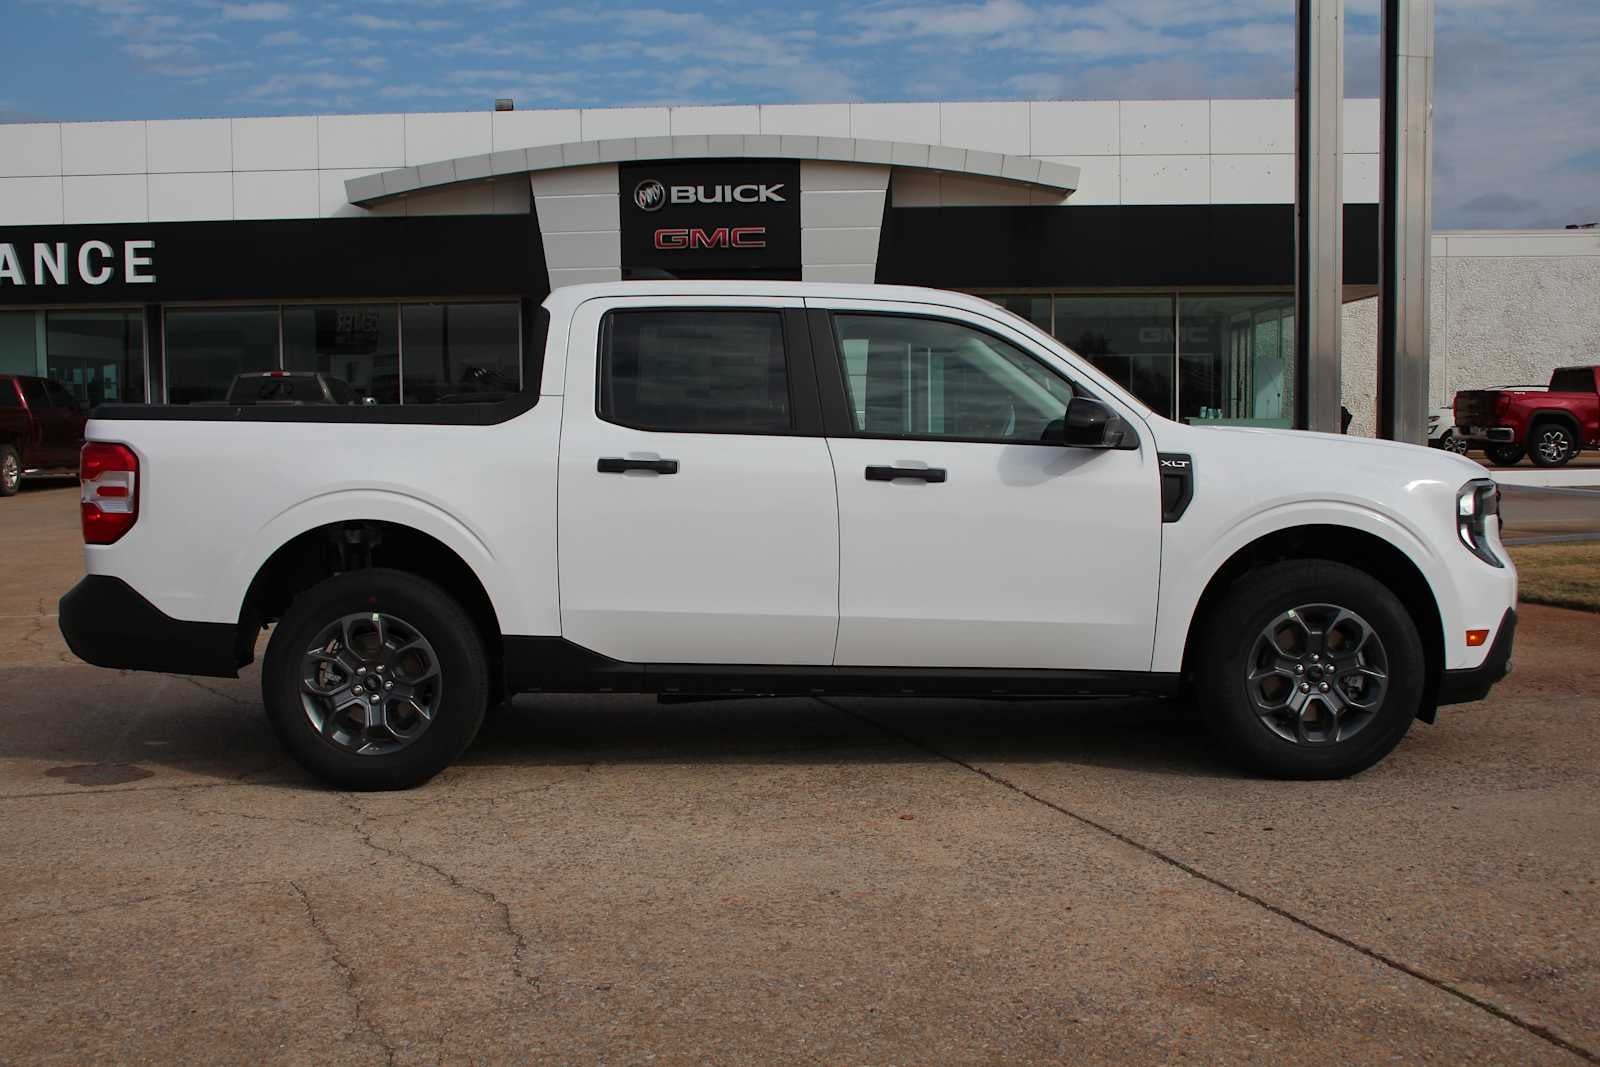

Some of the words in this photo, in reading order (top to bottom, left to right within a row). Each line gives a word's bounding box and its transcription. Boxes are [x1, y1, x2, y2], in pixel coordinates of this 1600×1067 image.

[670, 183, 787, 204] BUICK
[654, 227, 767, 250] GMC
[1160, 459, 1190, 468] XLT
